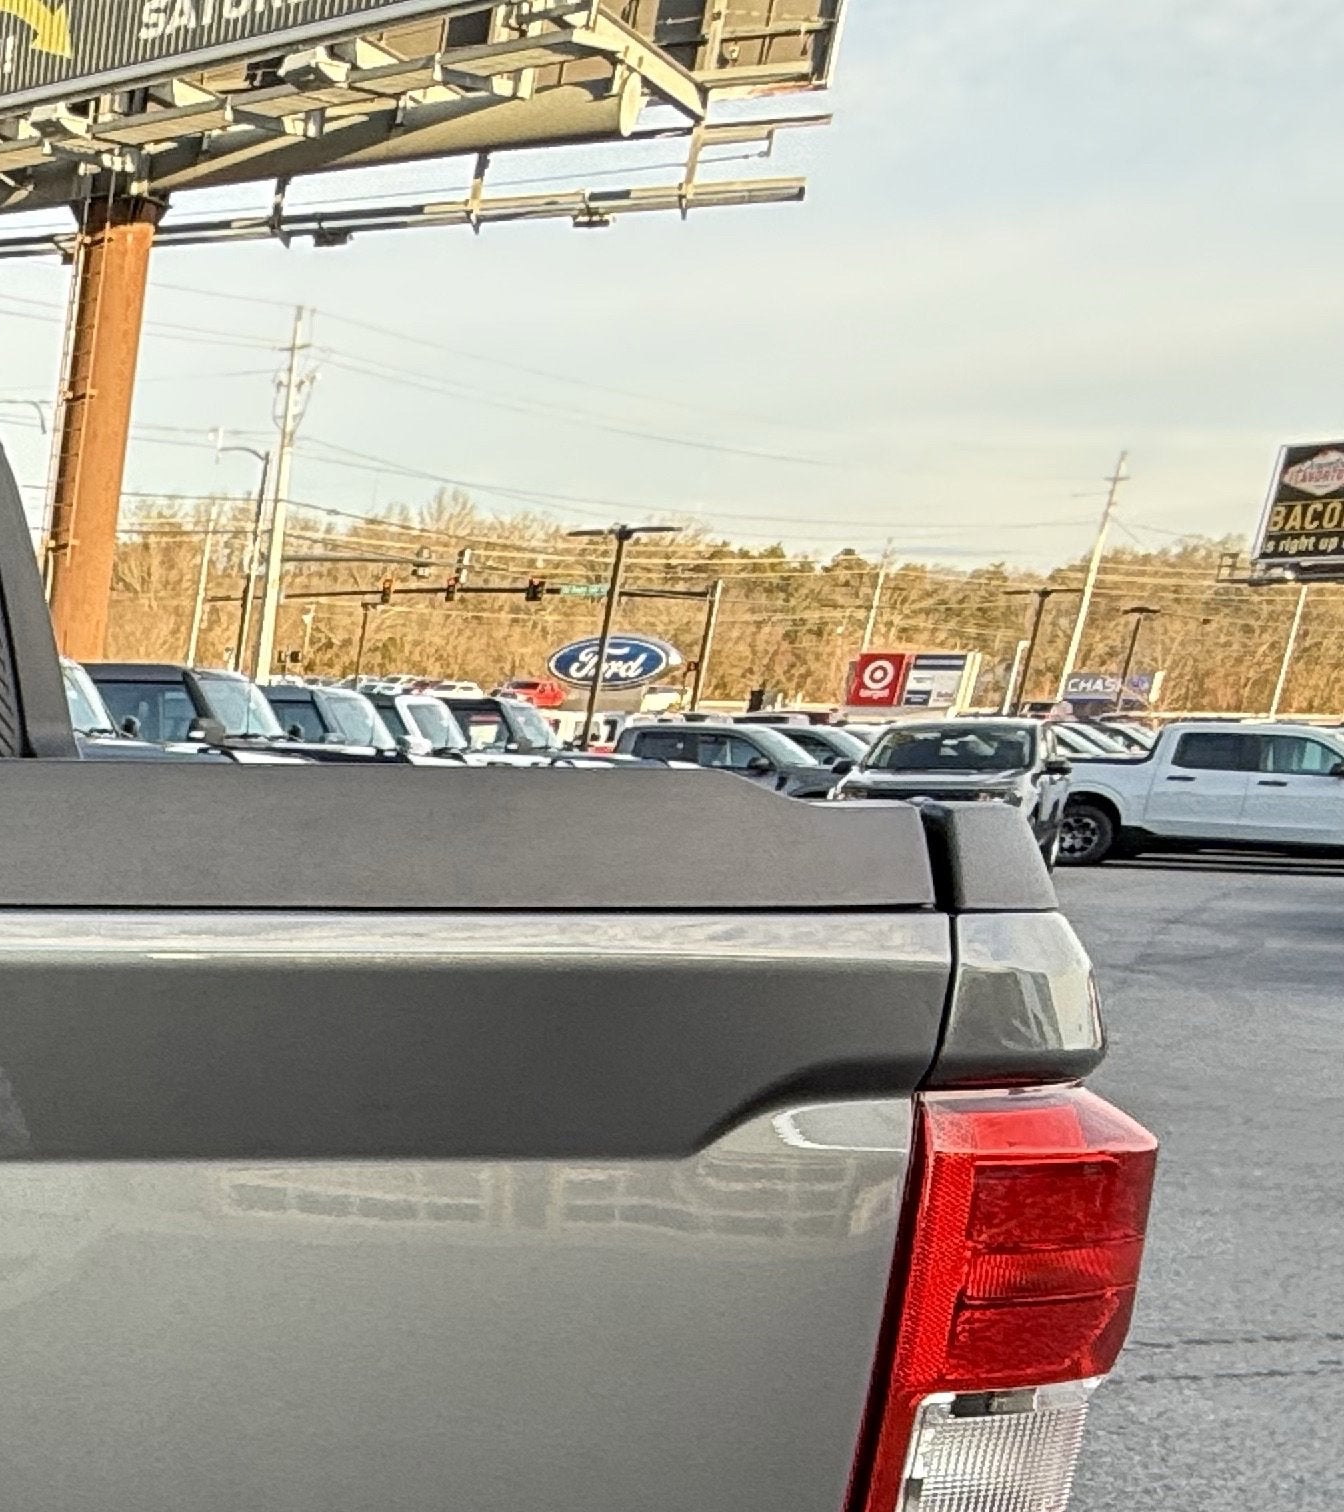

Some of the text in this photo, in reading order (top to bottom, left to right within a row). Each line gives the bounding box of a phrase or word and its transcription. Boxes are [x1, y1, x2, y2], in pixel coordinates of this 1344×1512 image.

[1268, 501, 1344, 532] BACO
[1278, 536, 1316, 554] right
[1318, 536, 1339, 553] up
